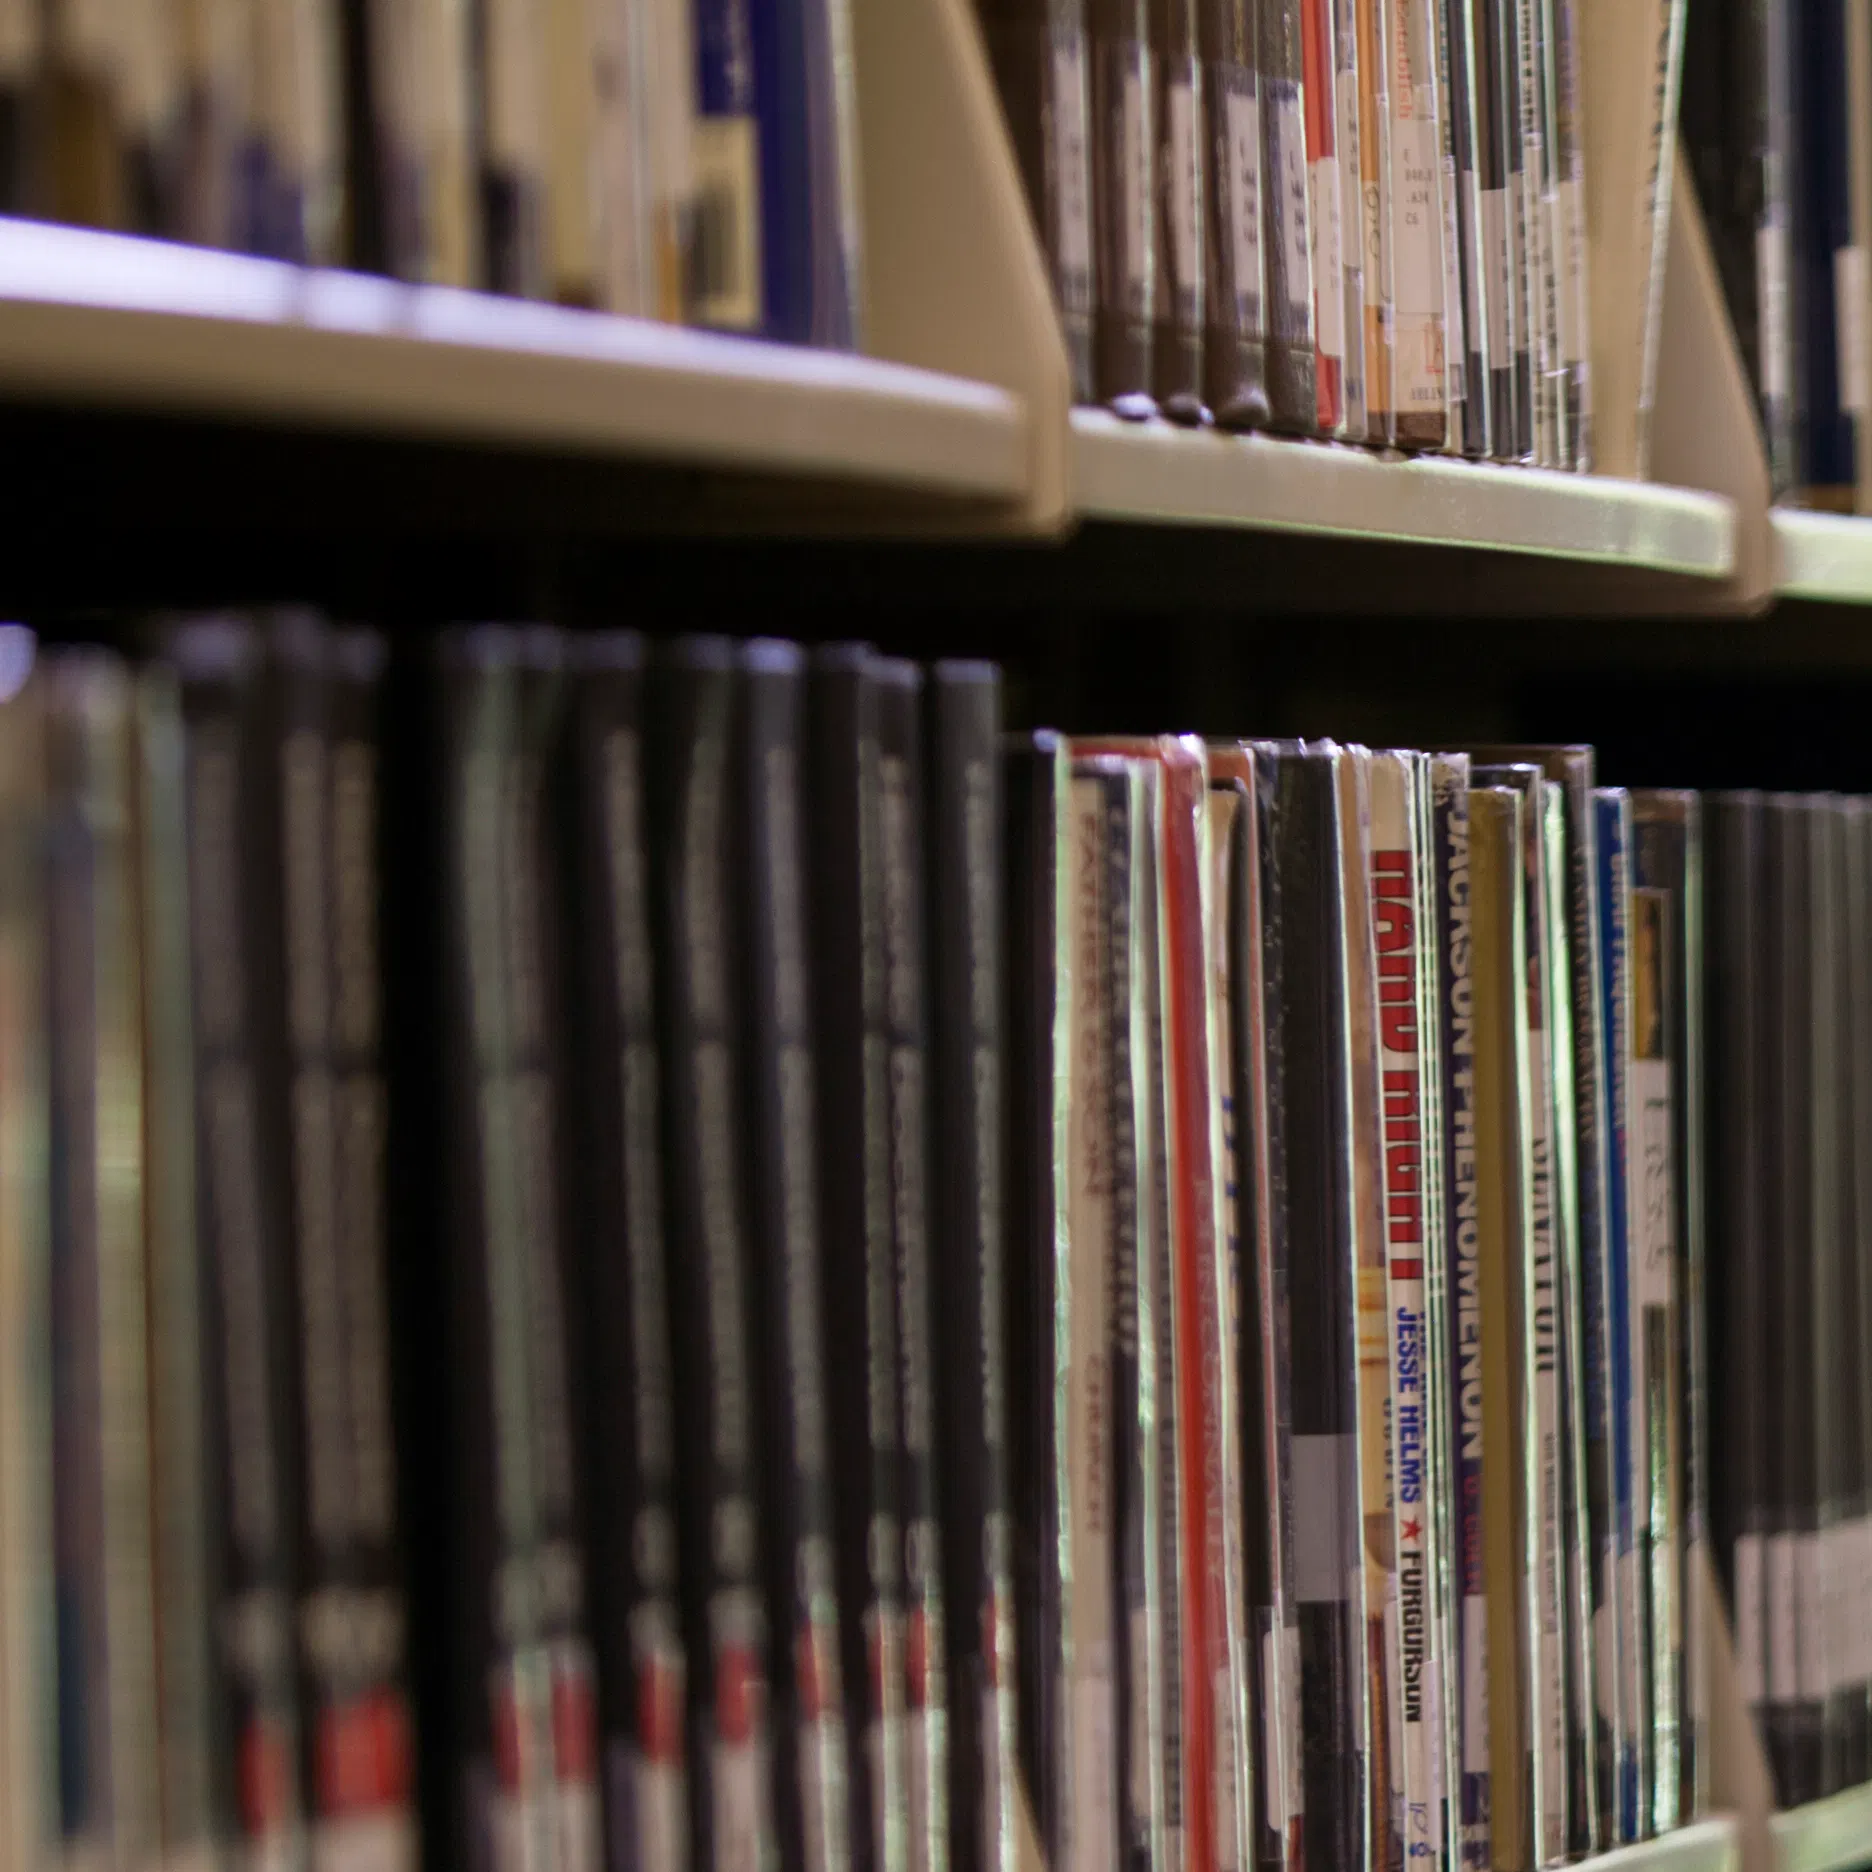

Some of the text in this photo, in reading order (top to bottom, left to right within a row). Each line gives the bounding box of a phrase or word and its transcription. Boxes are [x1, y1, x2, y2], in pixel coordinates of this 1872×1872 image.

[1369, 849, 1425, 1282] HARD RIGHT
[1446, 809, 1486, 1461] JACKSON PHENOMENON
[1396, 1306, 1424, 1504] JESSE HELMS
[1401, 1550, 1426, 1724] FURGURSON
